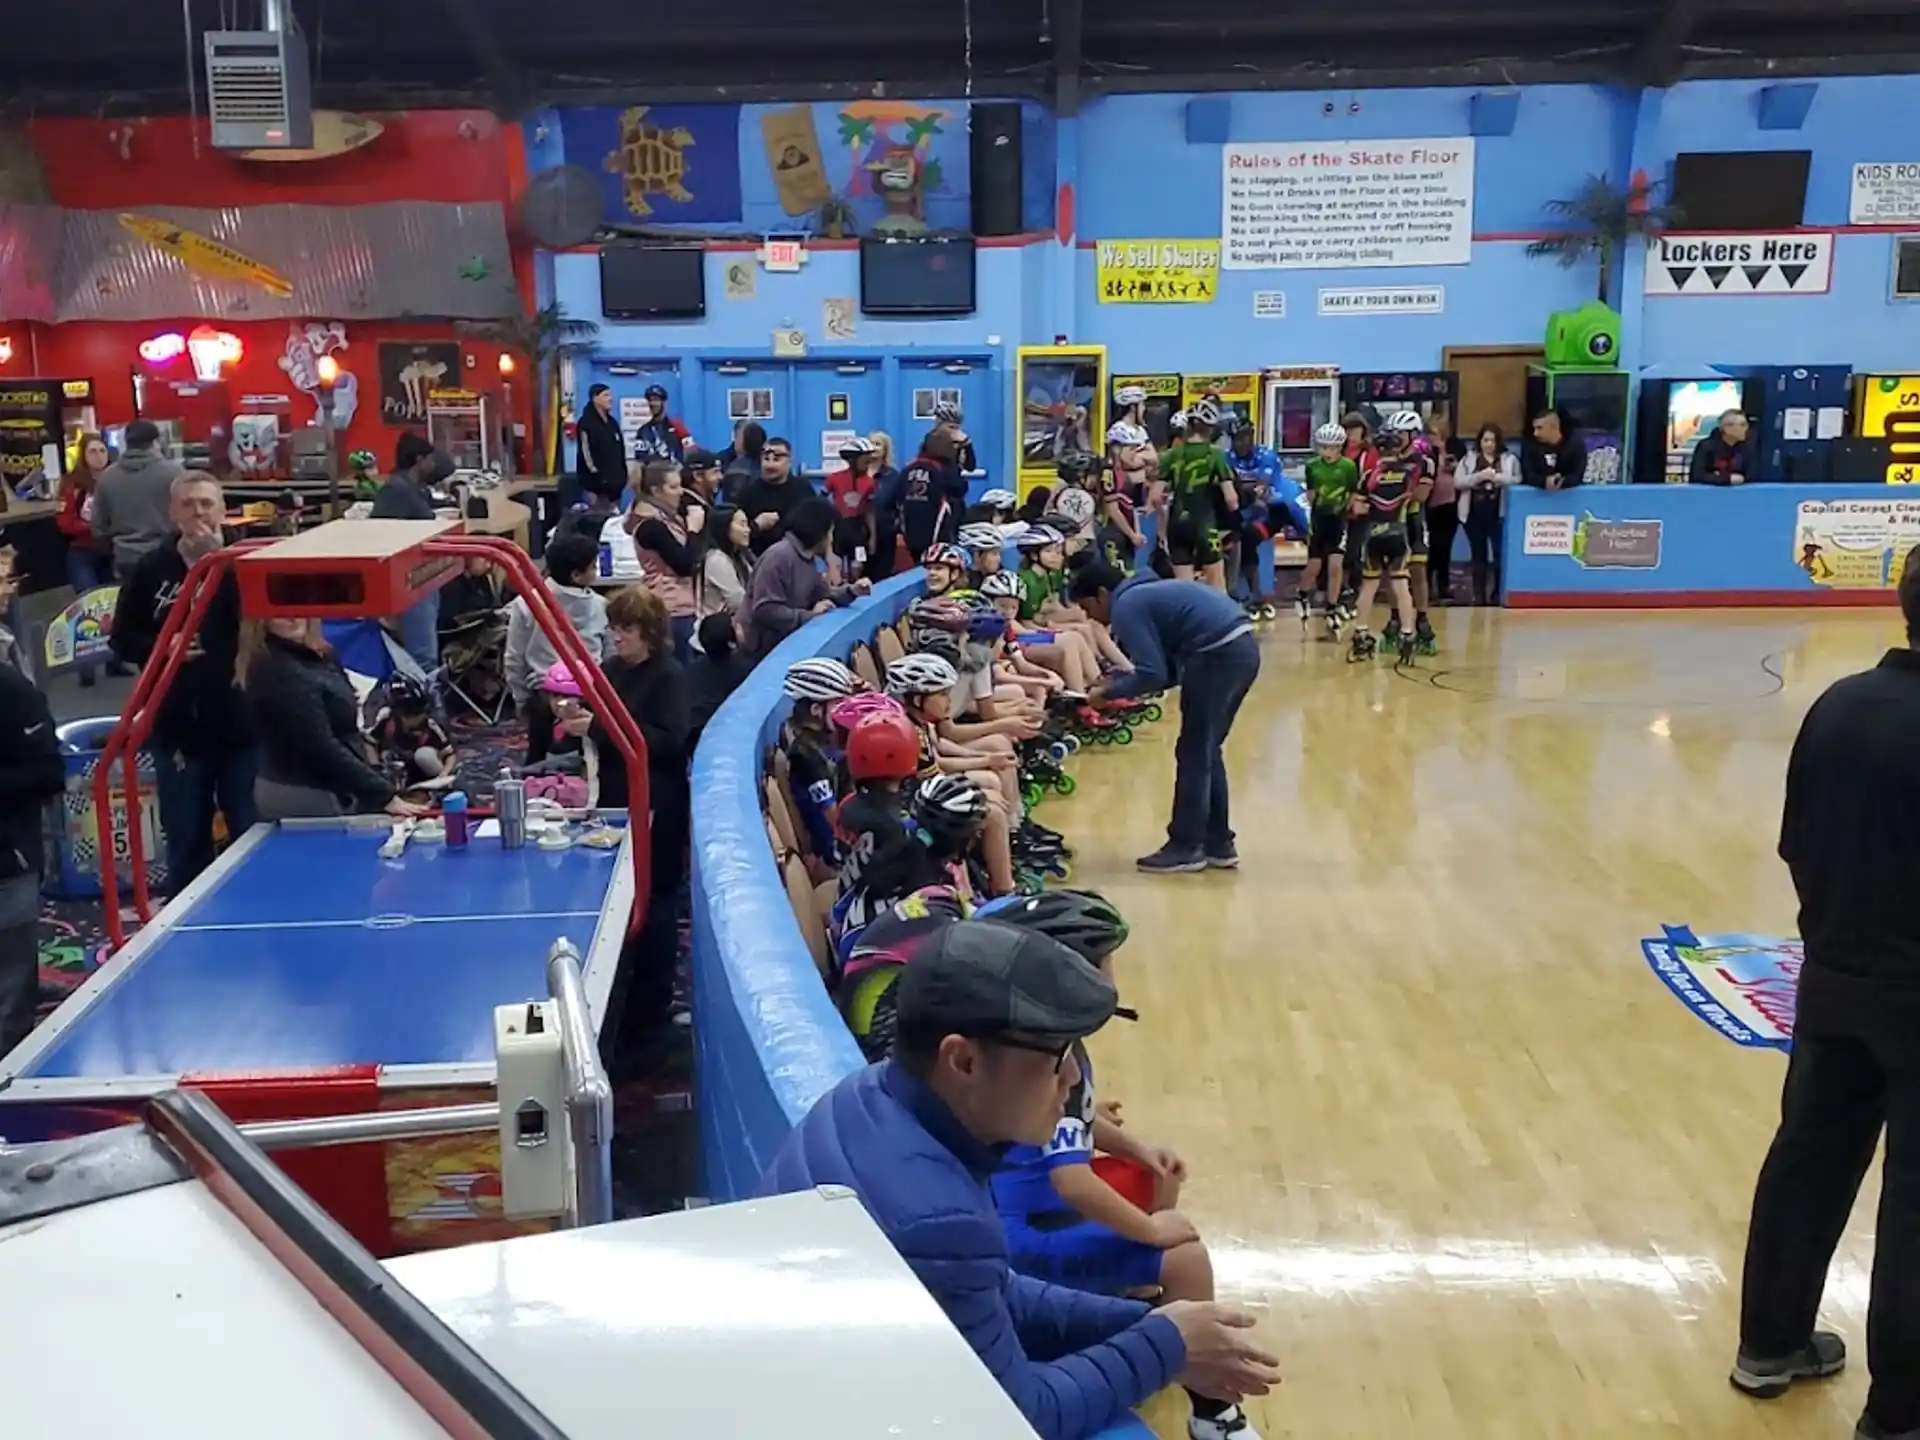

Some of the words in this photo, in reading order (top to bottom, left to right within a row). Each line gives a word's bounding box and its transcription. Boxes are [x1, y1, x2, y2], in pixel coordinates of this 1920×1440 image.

[1230, 154, 1281, 168] Rules
[1288, 153, 1306, 167] of
[1312, 152, 1343, 166] the
[1349, 151, 1404, 165] Skate
[1411, 149, 1459, 163] Floor
[1372, 173, 1390, 181] the
[1393, 172, 1417, 180] blue
[1420, 171, 1443, 179] wall
[1857, 165, 1892, 180] KIDS
[1287, 188, 1320, 197] Drinks
[1339, 187, 1356, 195] the
[1359, 187, 1385, 195] Floor
[1389, 186, 1400, 194] at
[1402, 187, 1420, 195] any
[1277, 203, 1322, 211] chewing
[1326, 201, 1337, 209] at
[1341, 200, 1384, 209] anytime
[1401, 199, 1419, 207] the
[1423, 199, 1466, 207] building
[1231, 215, 1246, 223] No
[1250, 215, 1298, 223] blocking
[1302, 213, 1320, 221] the
[1408, 222, 1452, 231] housing
[1269, 239, 1291, 248] pick
[1326, 238, 1354, 246] carry
[1357, 236, 1402, 244] children
[1406, 235, 1450, 245] anytime
[771, 245, 795, 262] EXIT
[1103, 245, 1124, 268] We
[1128, 245, 1159, 268] Sell
[1163, 245, 1218, 268] Skates
[1661, 240, 1751, 262] Lockers
[1762, 239, 1818, 260] Here
[1324, 296, 1351, 306] SKATE
[1353, 296, 1363, 305] AT
[1366, 295, 1390, 305] YOUR
[1393, 294, 1413, 304] OWN
[1802, 504, 1846, 515] Capital
[1850, 504, 1892, 514] Carpet
[1600, 528, 1648, 541] Advertise
[114, 833, 127, 854] 5
